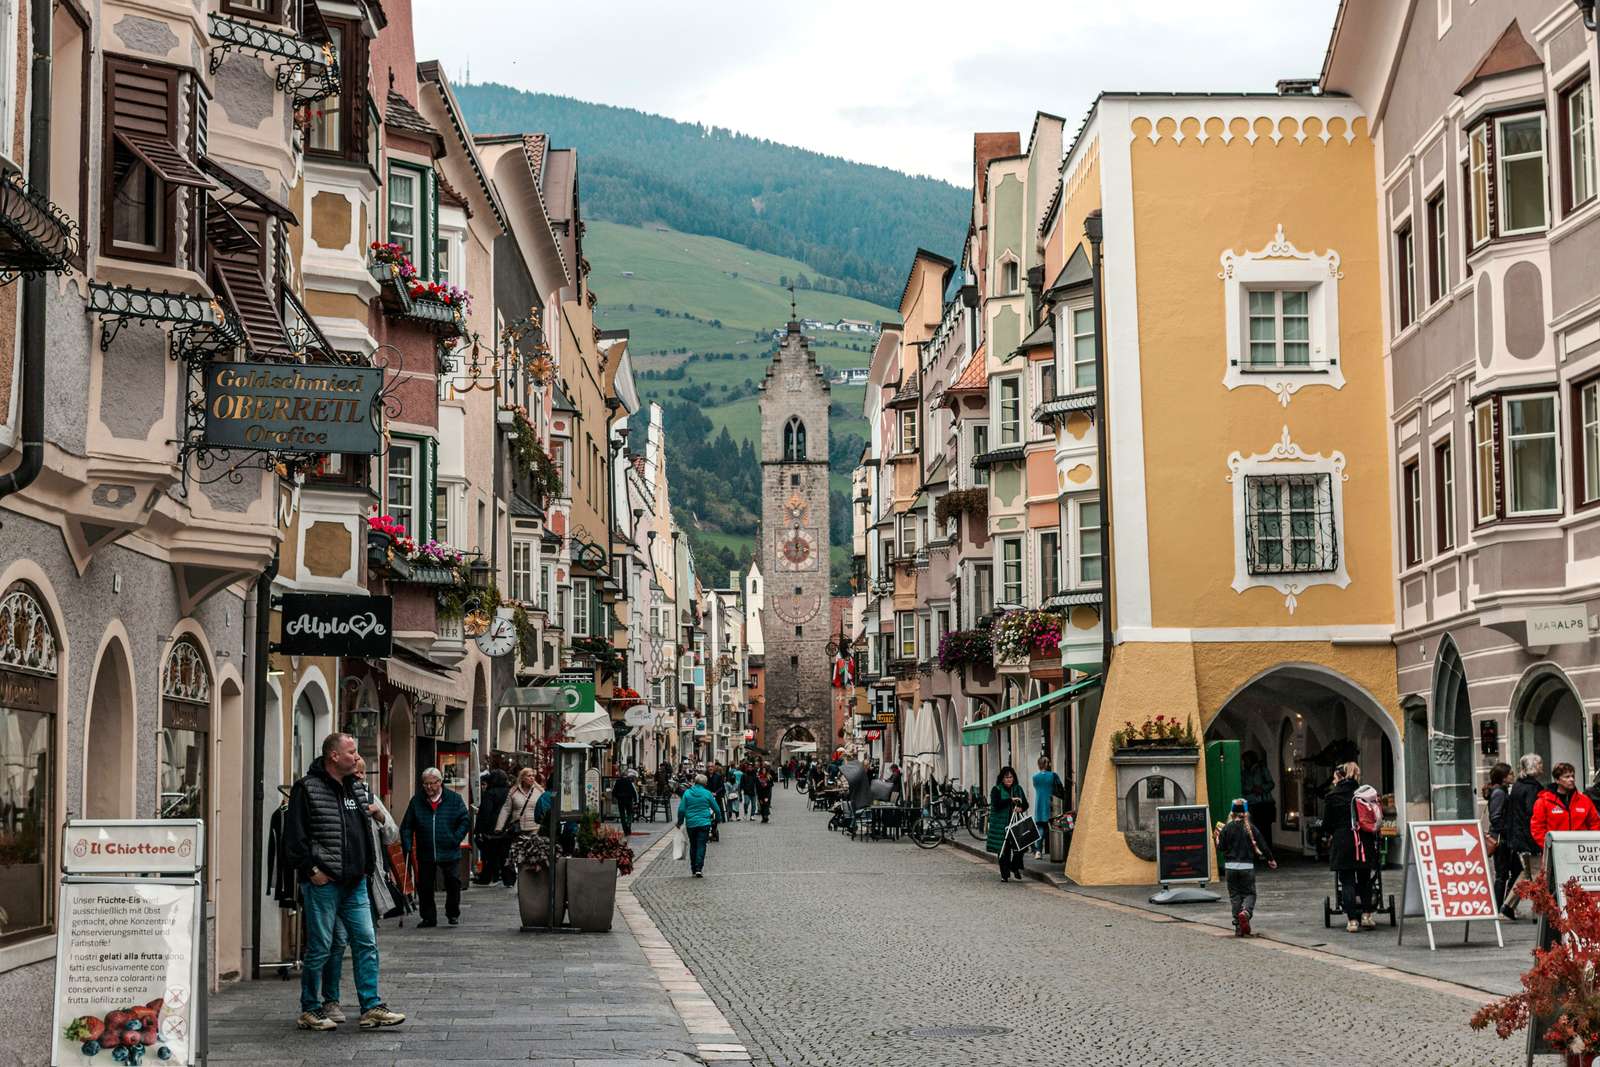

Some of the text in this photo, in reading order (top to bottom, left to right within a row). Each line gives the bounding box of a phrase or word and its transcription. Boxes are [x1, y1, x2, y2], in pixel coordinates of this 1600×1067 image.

[216, 368, 365, 392] Goldschmied
[212, 393, 365, 424] OBERRETL
[244, 424, 328, 445] Orefice
[1534, 619, 1584, 631] MARALPS
[1160, 812, 1205, 823] MARALPS
[90, 842, 176, 855] Il Ghiottone
[1417, 831, 1440, 916] OUTLET
[1439, 861, 1484, 876] -30%
[1442, 881, 1488, 896] -50%
[73, 896, 95, 905] Unser
[97, 896, 141, 904] Früchte-Eis
[129, 907, 142, 915] mit
[1446, 900, 1491, 916] -70%
[72, 918, 108, 928] gemacht,
[71, 929, 153, 938] Konservierungsmittel
[74, 952, 98, 961] nostri
[99, 952, 122, 962] gelati
[124, 952, 139, 960] alla
[141, 952, 163, 960] frutta
[86, 963, 149, 972] esclusivamente
[68, 975, 93, 983] frutta,
[120, 974, 155, 982] coloranti
[68, 985, 114, 993] conservanti
[67, 995, 135, 1004] frutta liofilizzata!
